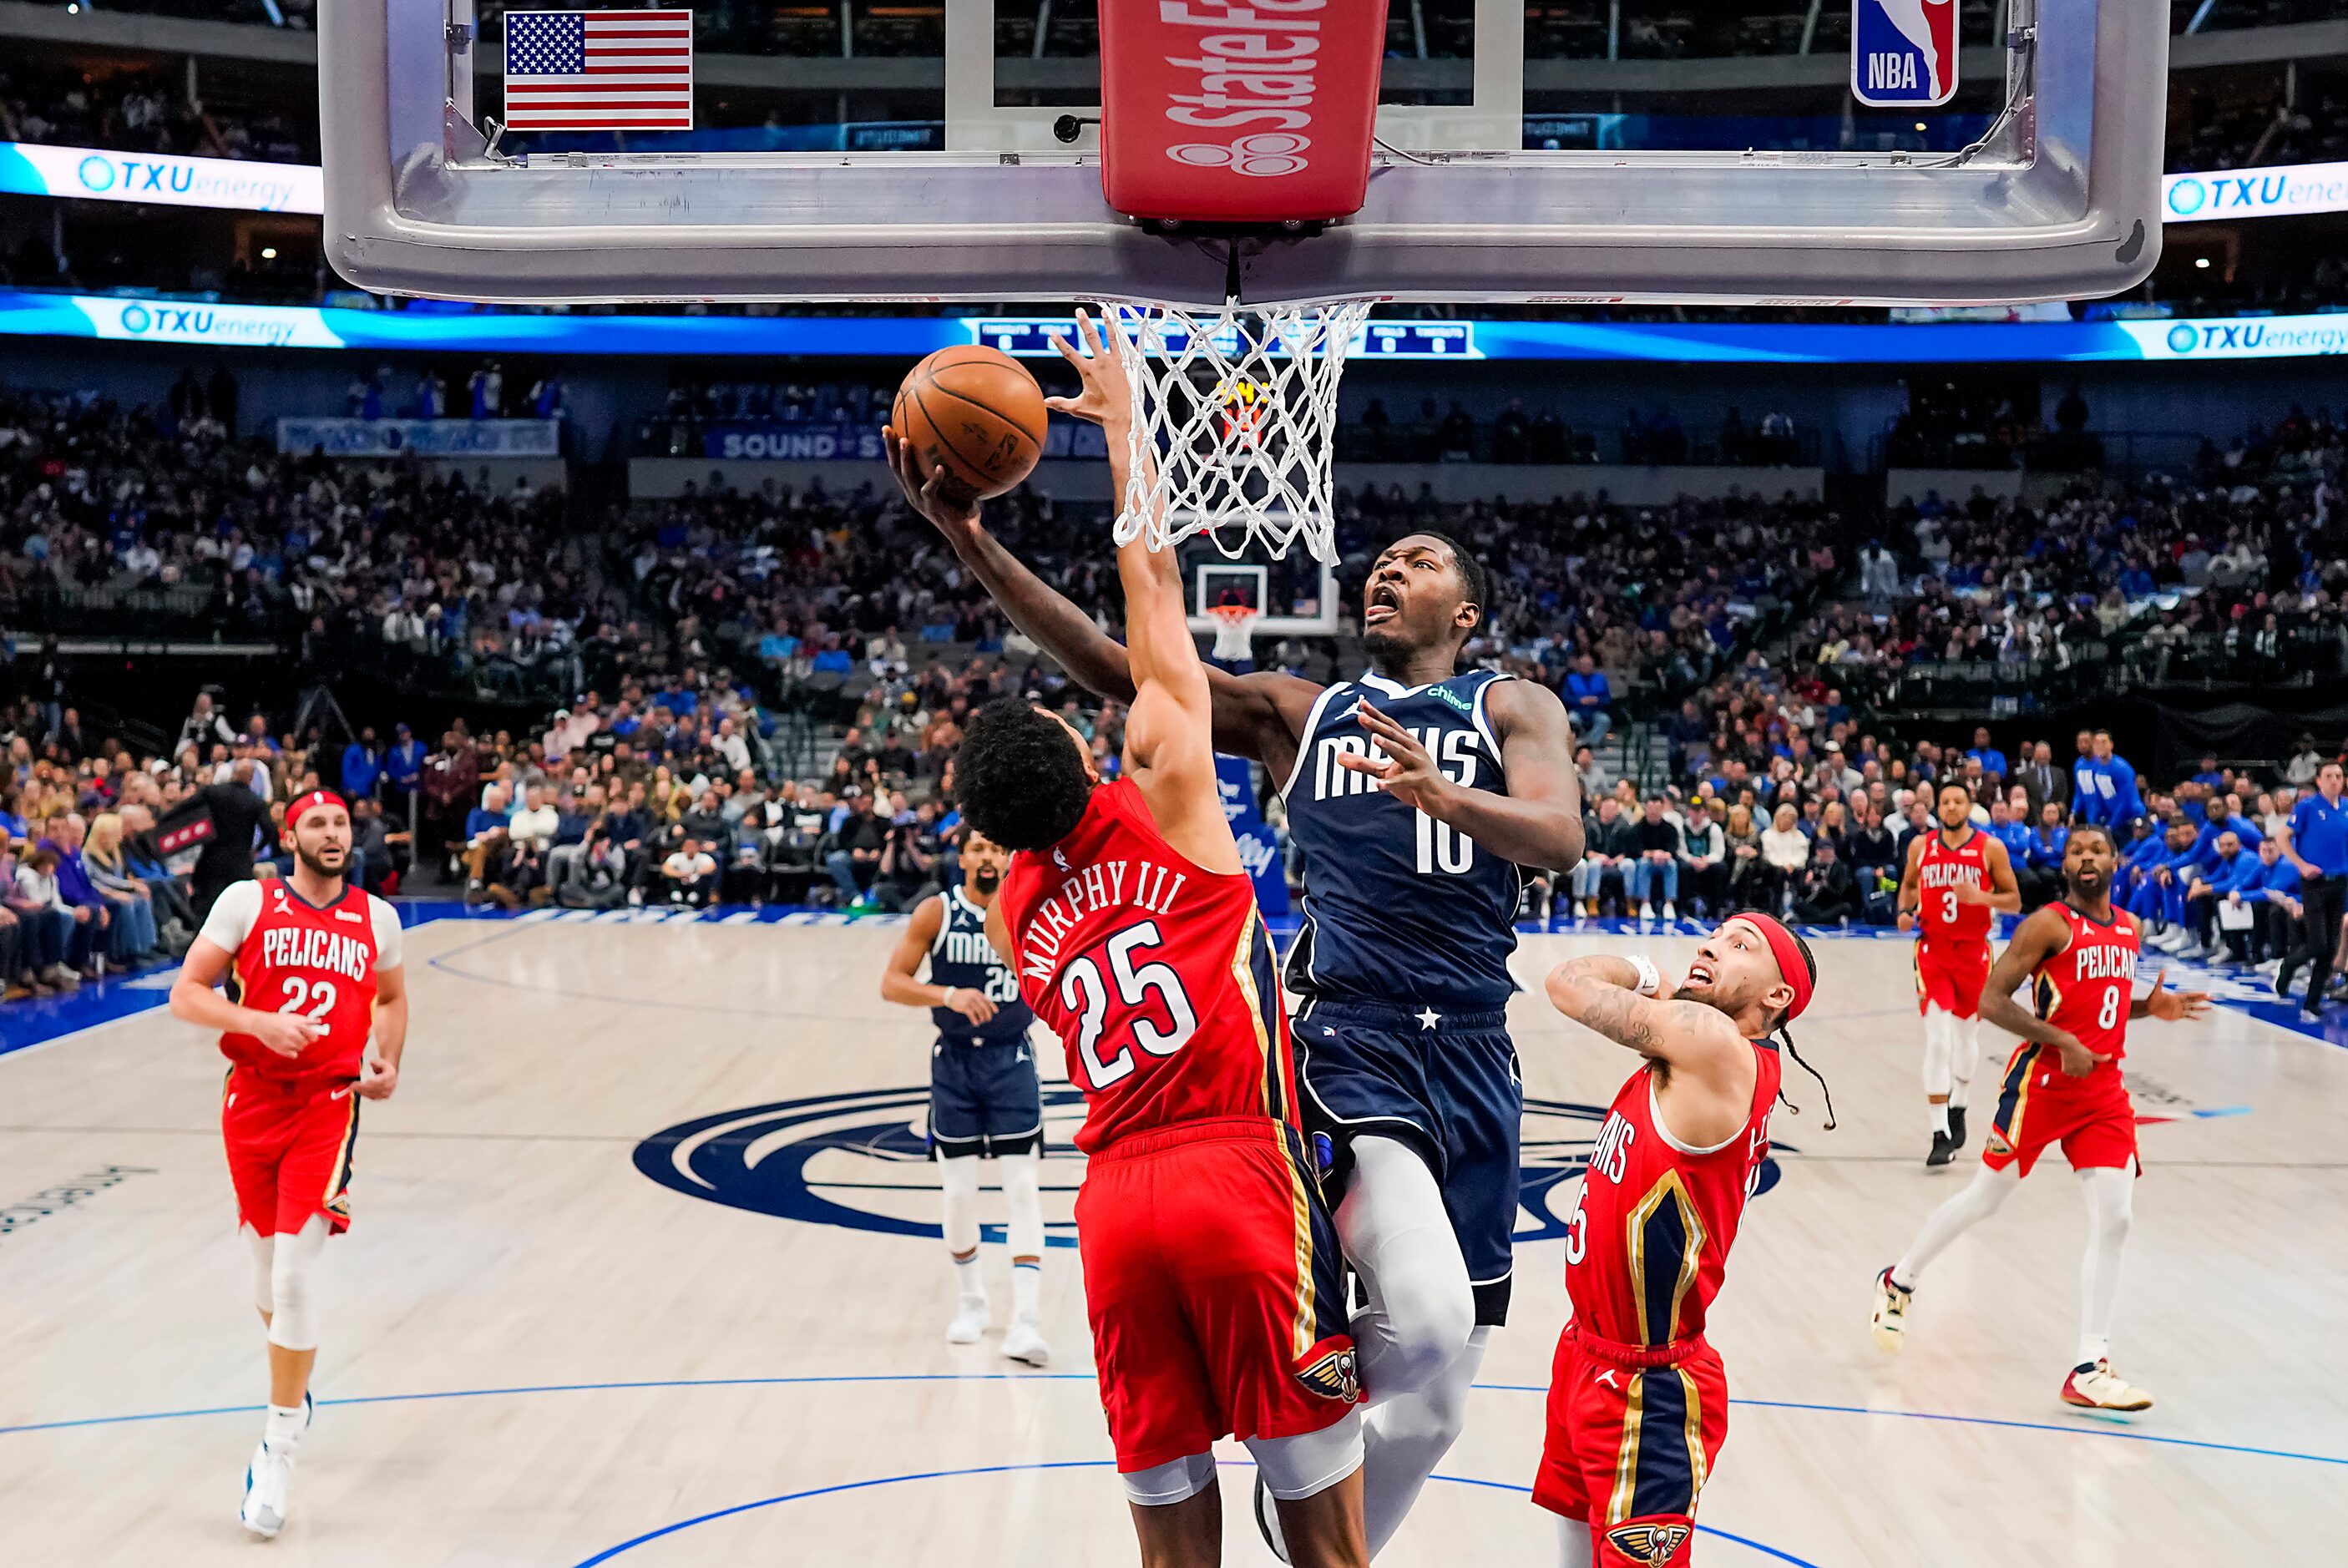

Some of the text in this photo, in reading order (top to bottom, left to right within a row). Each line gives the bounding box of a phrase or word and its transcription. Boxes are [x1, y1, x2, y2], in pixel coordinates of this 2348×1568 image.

[1869, 53, 1917, 89] NBA
[723, 433, 836, 458] SOUND
[1427, 685, 1473, 710] chime
[1922, 862, 1981, 890] PELICANS
[1022, 861, 1186, 985] MURPHY III
[1941, 891, 1958, 923] 3
[263, 928, 369, 982] PELICANS
[984, 966, 1020, 1003] 26
[278, 976, 337, 1036] 22
[1060, 918, 1199, 1090] 25
[2098, 985, 2119, 1030] 8
